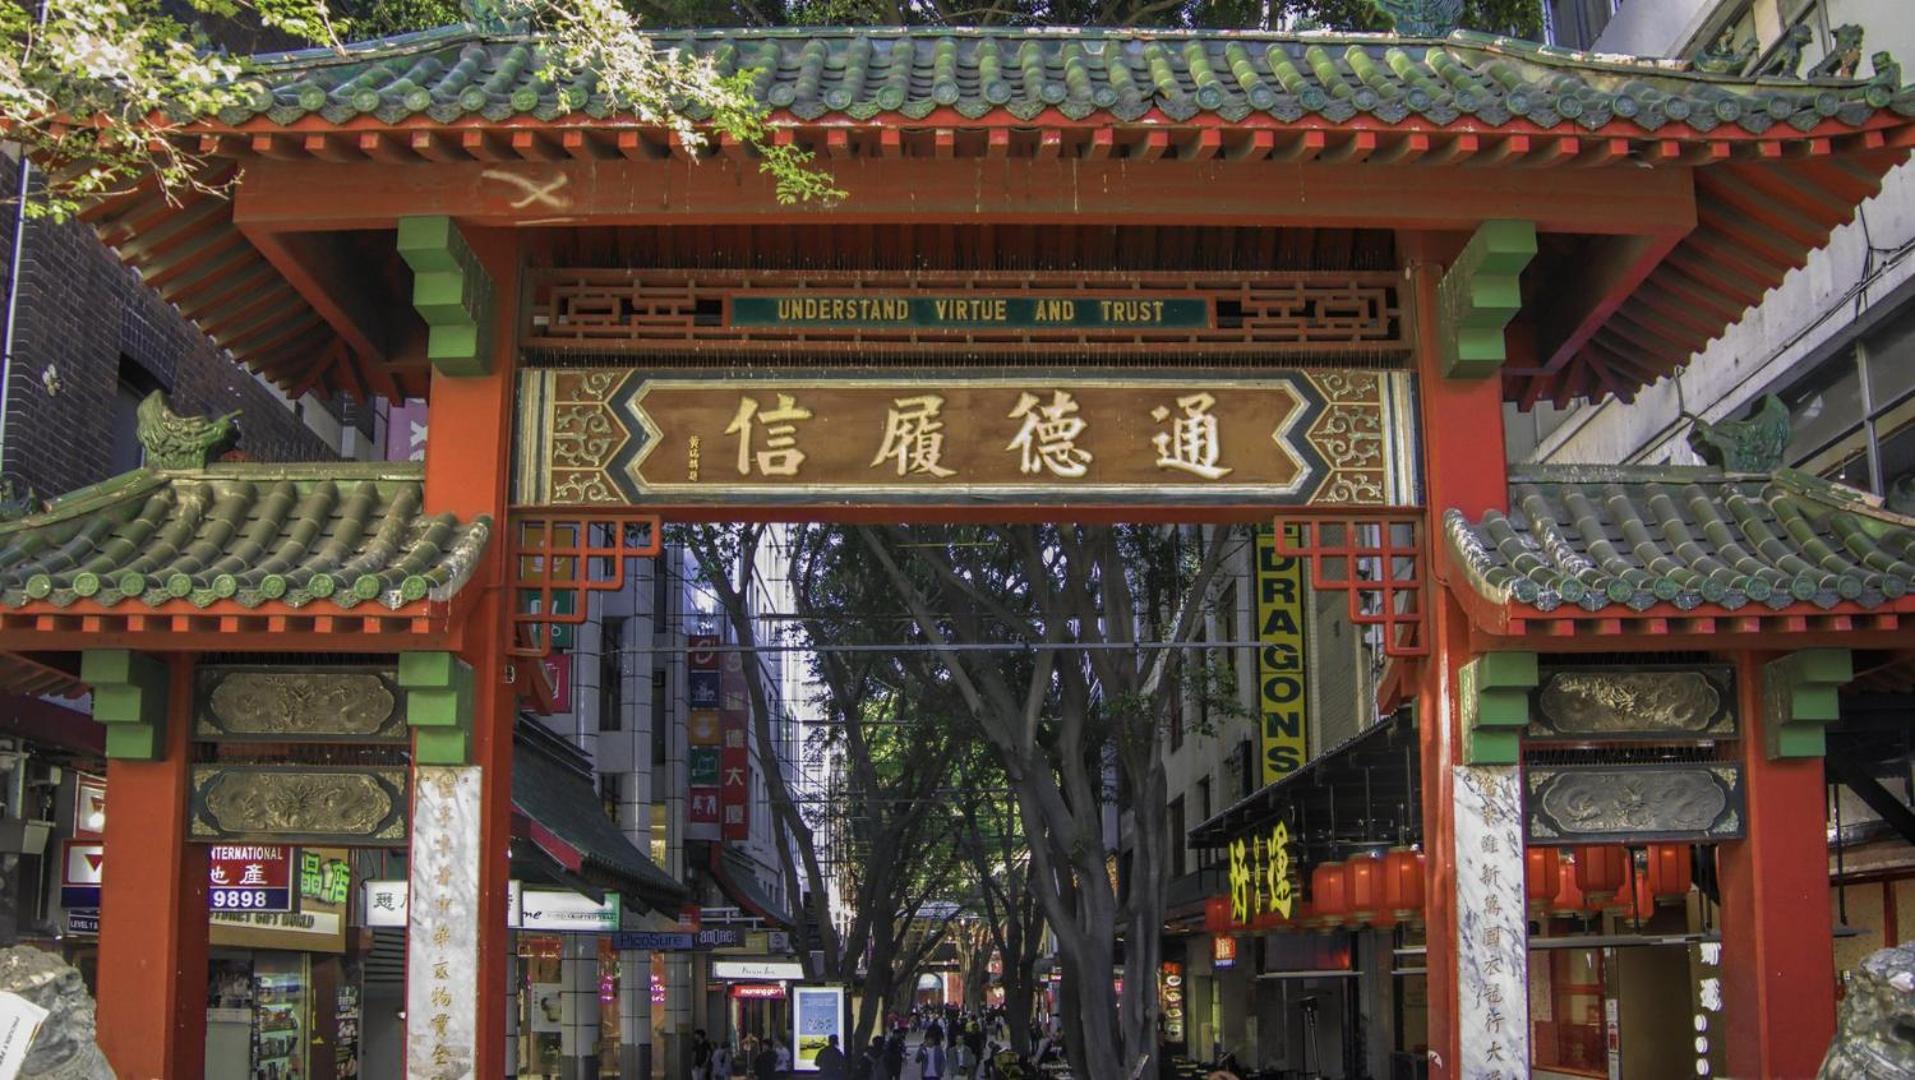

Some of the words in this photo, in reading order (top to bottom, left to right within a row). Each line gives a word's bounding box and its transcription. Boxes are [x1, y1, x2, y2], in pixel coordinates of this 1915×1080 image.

[778, 299, 909, 320] UNDERSTAND
[935, 300, 1007, 321] VIRTUE
[1034, 300, 1075, 321] AND
[1100, 300, 1164, 322] TRUST
[1260, 546, 1302, 774] DRAGONS
[213, 890, 267, 908] 9898
[70, 919, 88, 929] LEVEL
